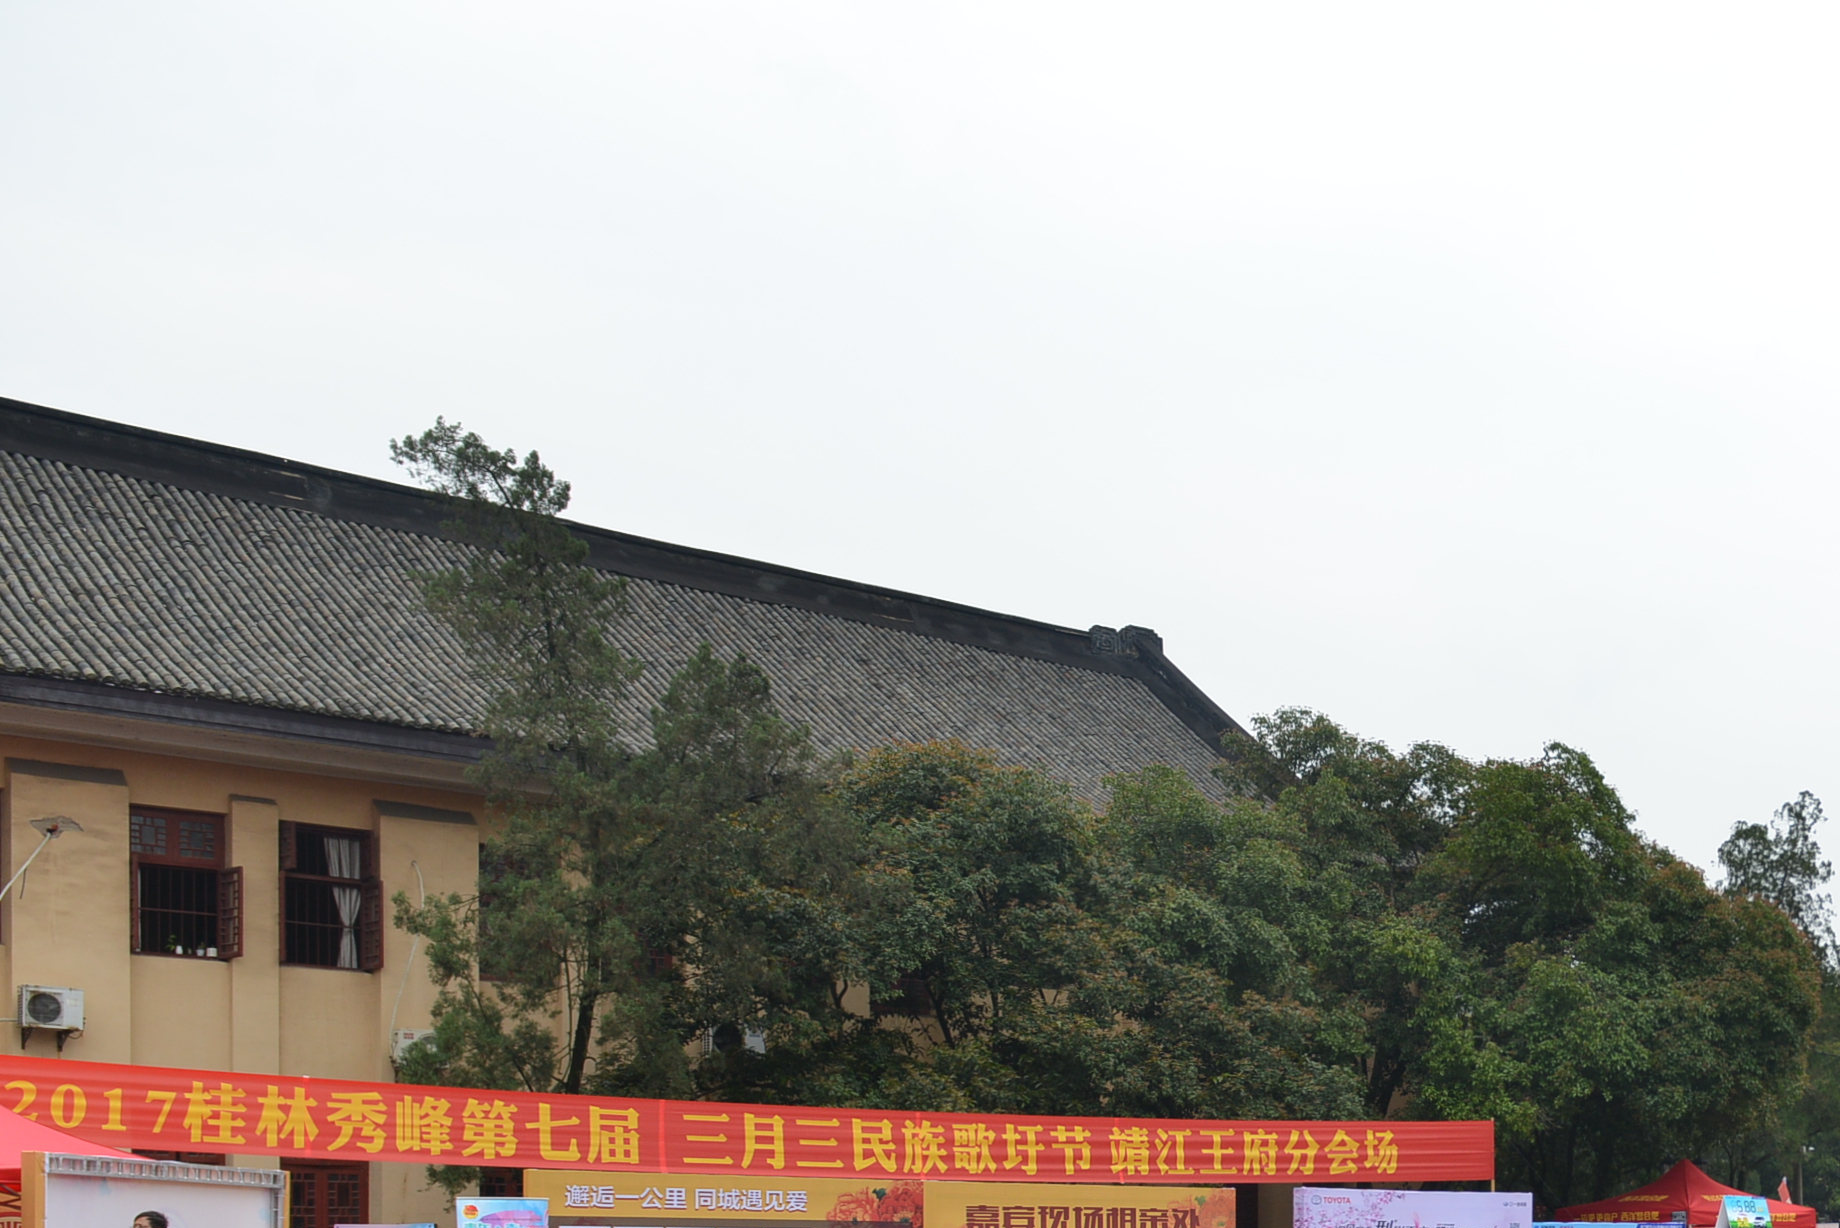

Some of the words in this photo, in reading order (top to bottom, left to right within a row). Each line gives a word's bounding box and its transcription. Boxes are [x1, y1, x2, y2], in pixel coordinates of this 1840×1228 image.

[4, 1080, 640, 1164] 2017桂林秀峰第七届
[683, 1113, 1091, 1175] 三月三民族歌圩节
[1109, 1126, 1398, 1175] 靖江王府分会场
[565, 1185, 687, 1211] 邂逅一公里
[695, 1188, 808, 1213] 同城遇见爱
[1323, 1196, 1351, 1204] TOYOTA
